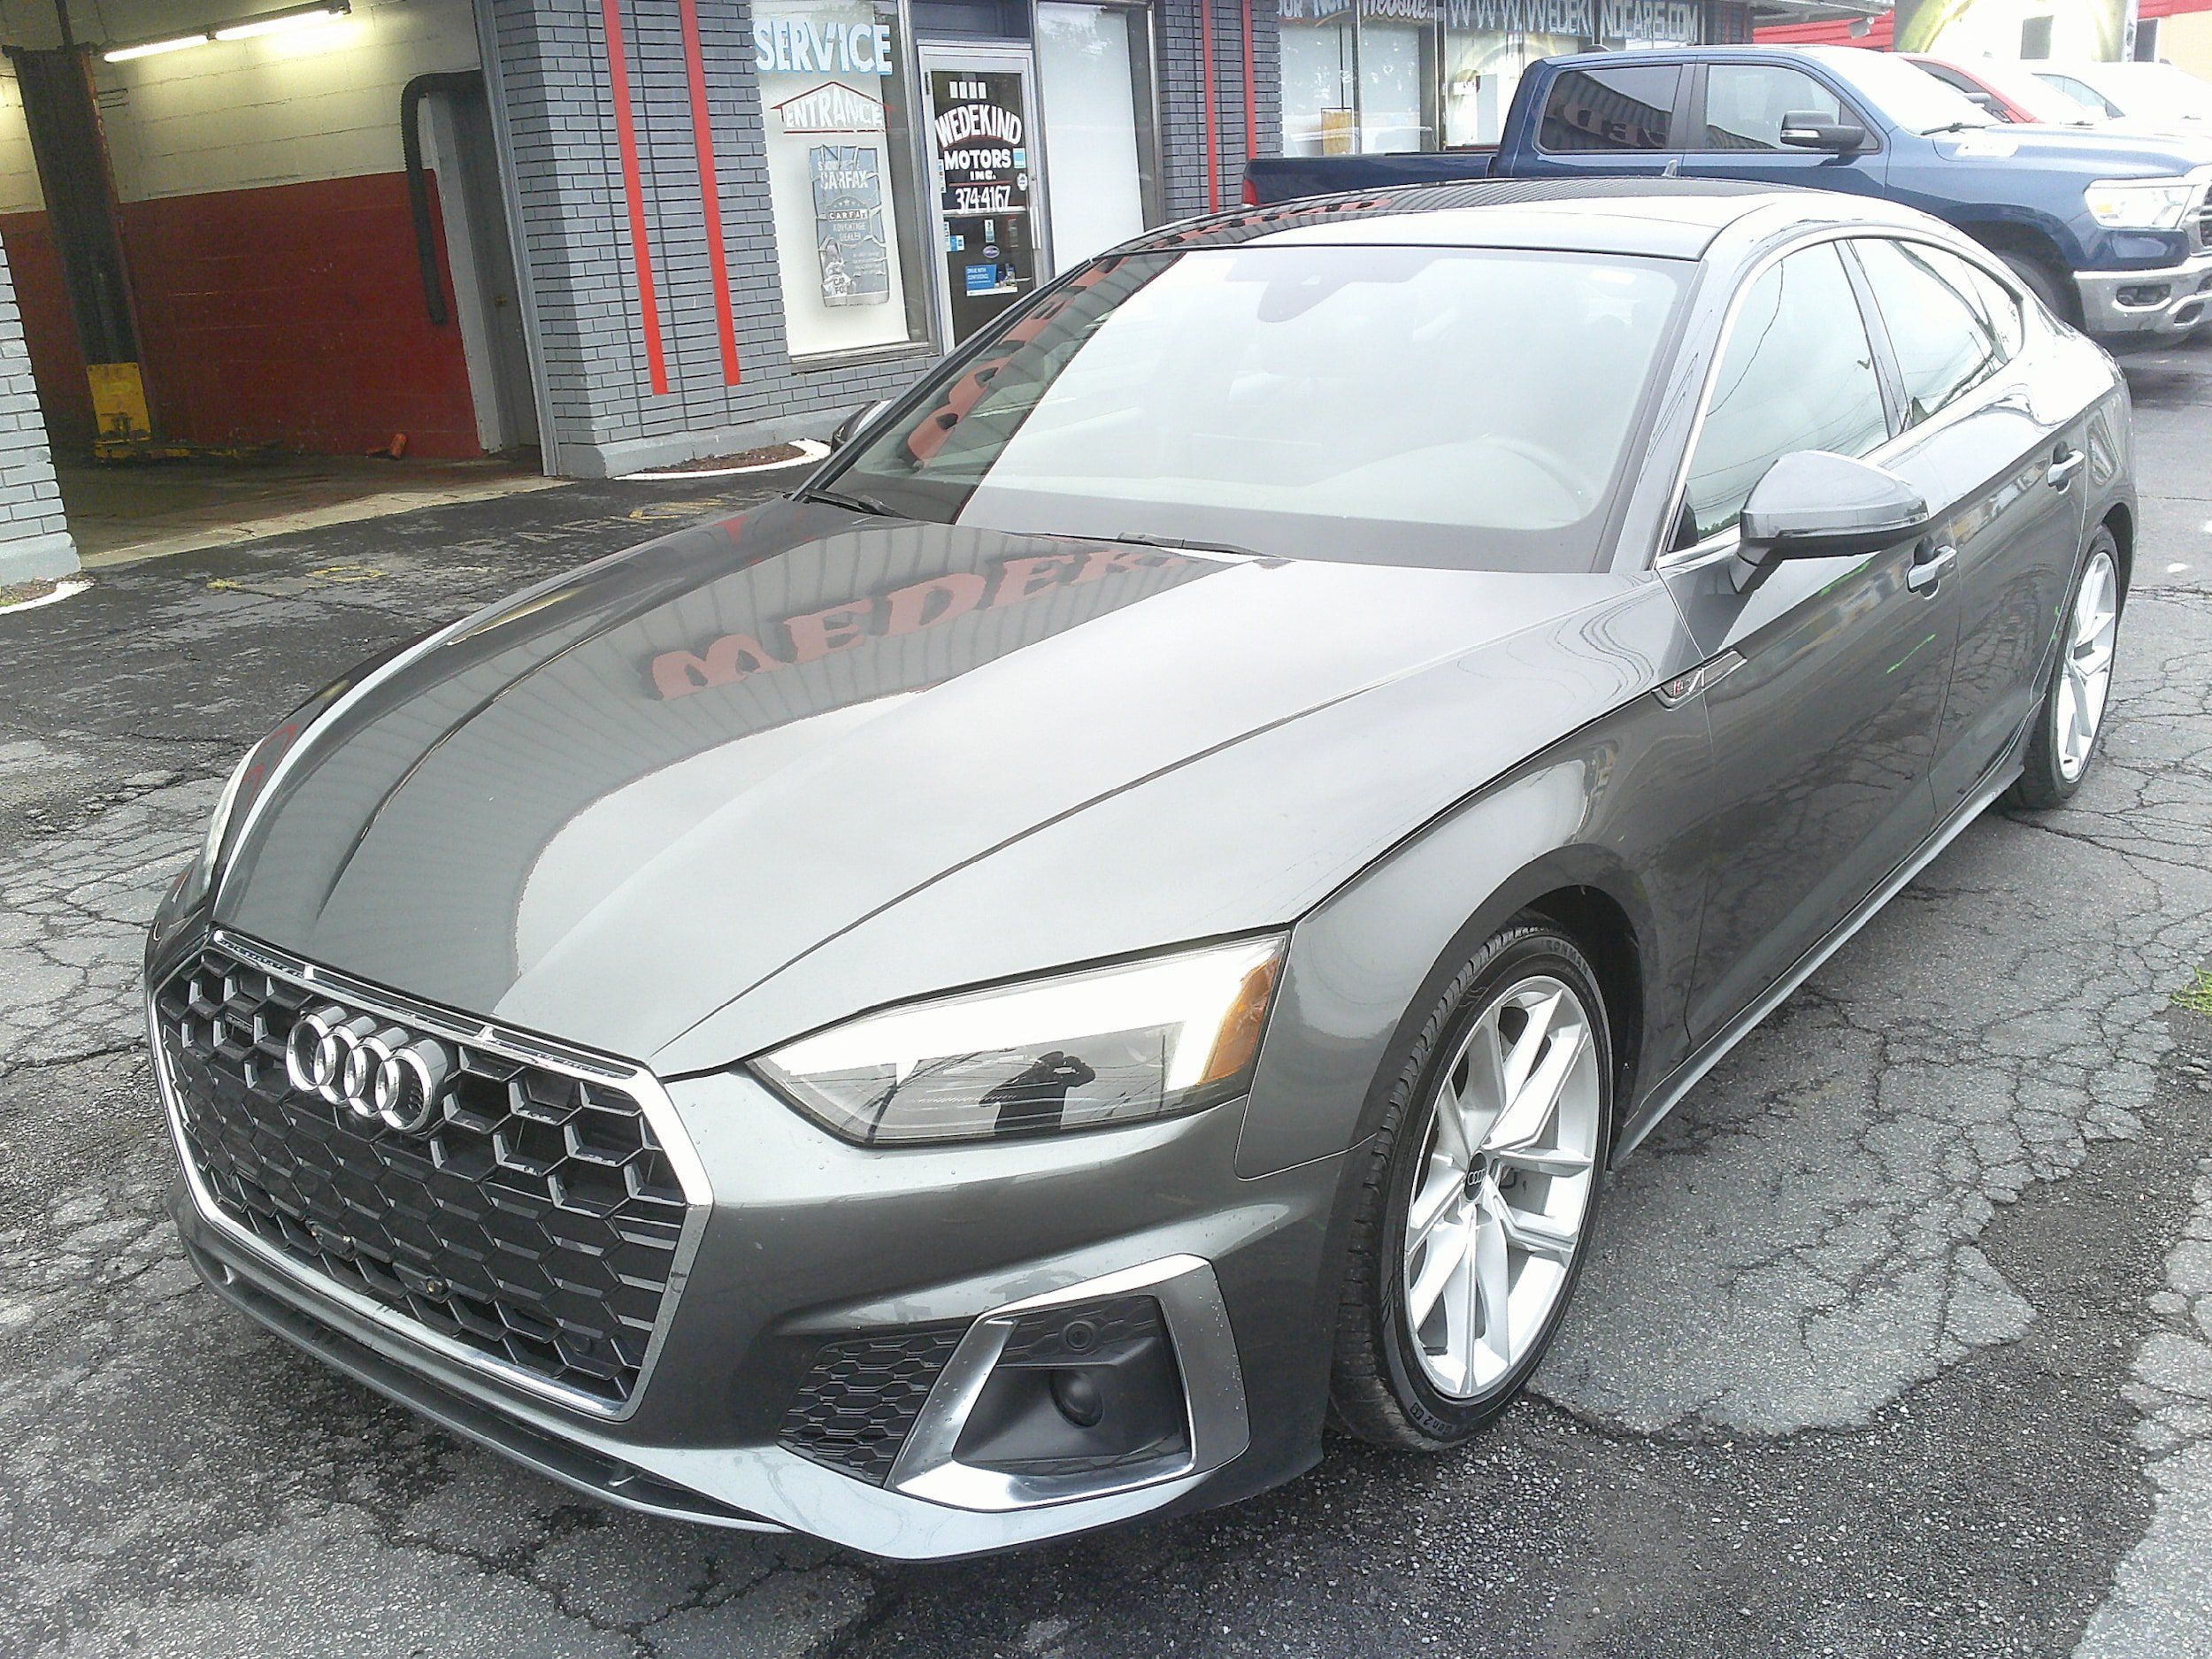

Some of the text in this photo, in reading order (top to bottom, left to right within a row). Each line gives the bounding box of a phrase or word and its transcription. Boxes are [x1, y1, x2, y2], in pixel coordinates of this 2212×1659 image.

[753, 19, 893, 75] SERVICE
[785, 89, 884, 128] ENTRANCE
[934, 104, 1022, 148] WEDEKIND
[943, 149, 1012, 170] MOTORS
[820, 170, 869, 190] CARFAX
[970, 170, 997, 180] INC.
[956, 185, 1011, 214] 374-4167
